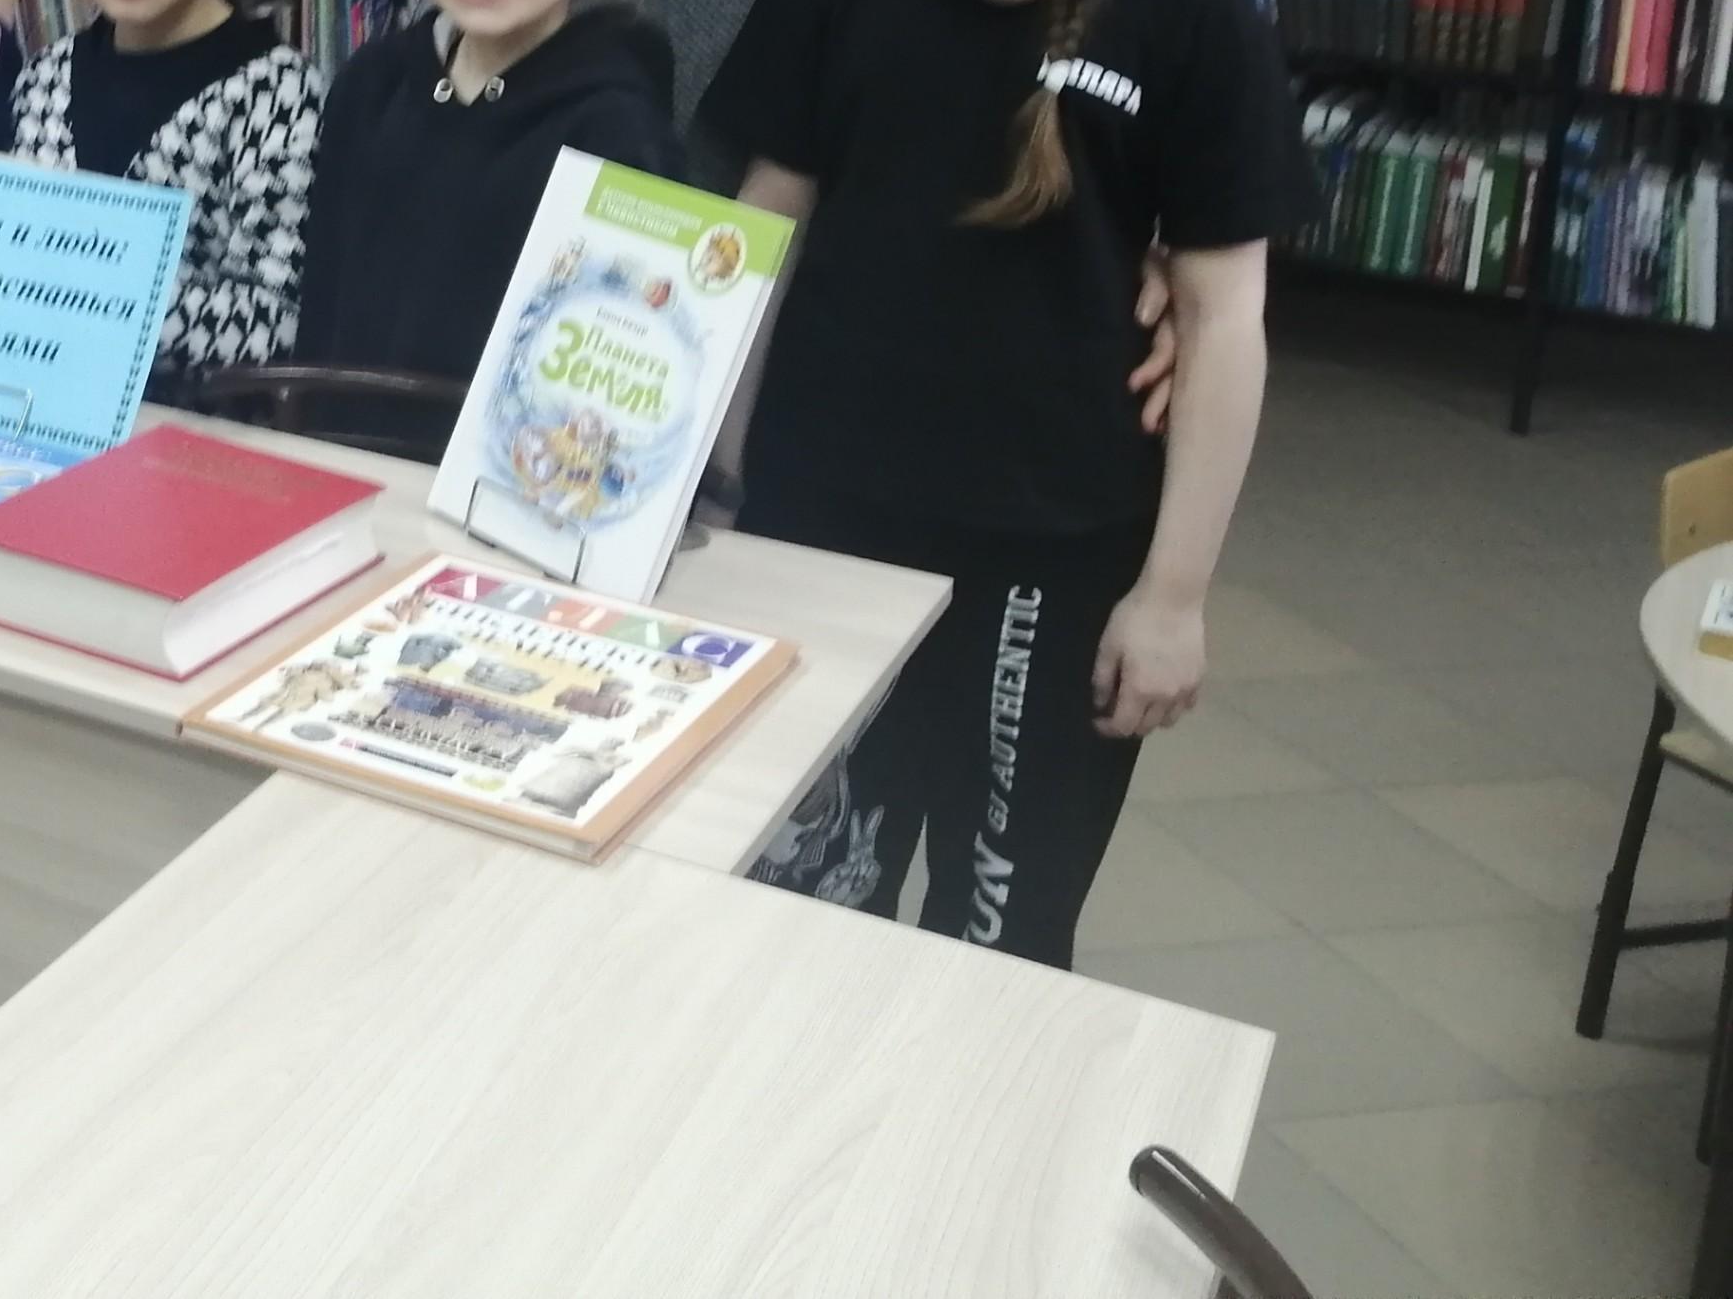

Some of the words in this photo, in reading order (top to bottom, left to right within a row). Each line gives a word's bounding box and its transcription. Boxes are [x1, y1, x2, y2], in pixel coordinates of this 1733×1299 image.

[11, 220, 32, 247] и
[539, 319, 665, 414] Земля
[585, 325, 669, 380] Планета
[990, 585, 1043, 791] AUTHENTIC
